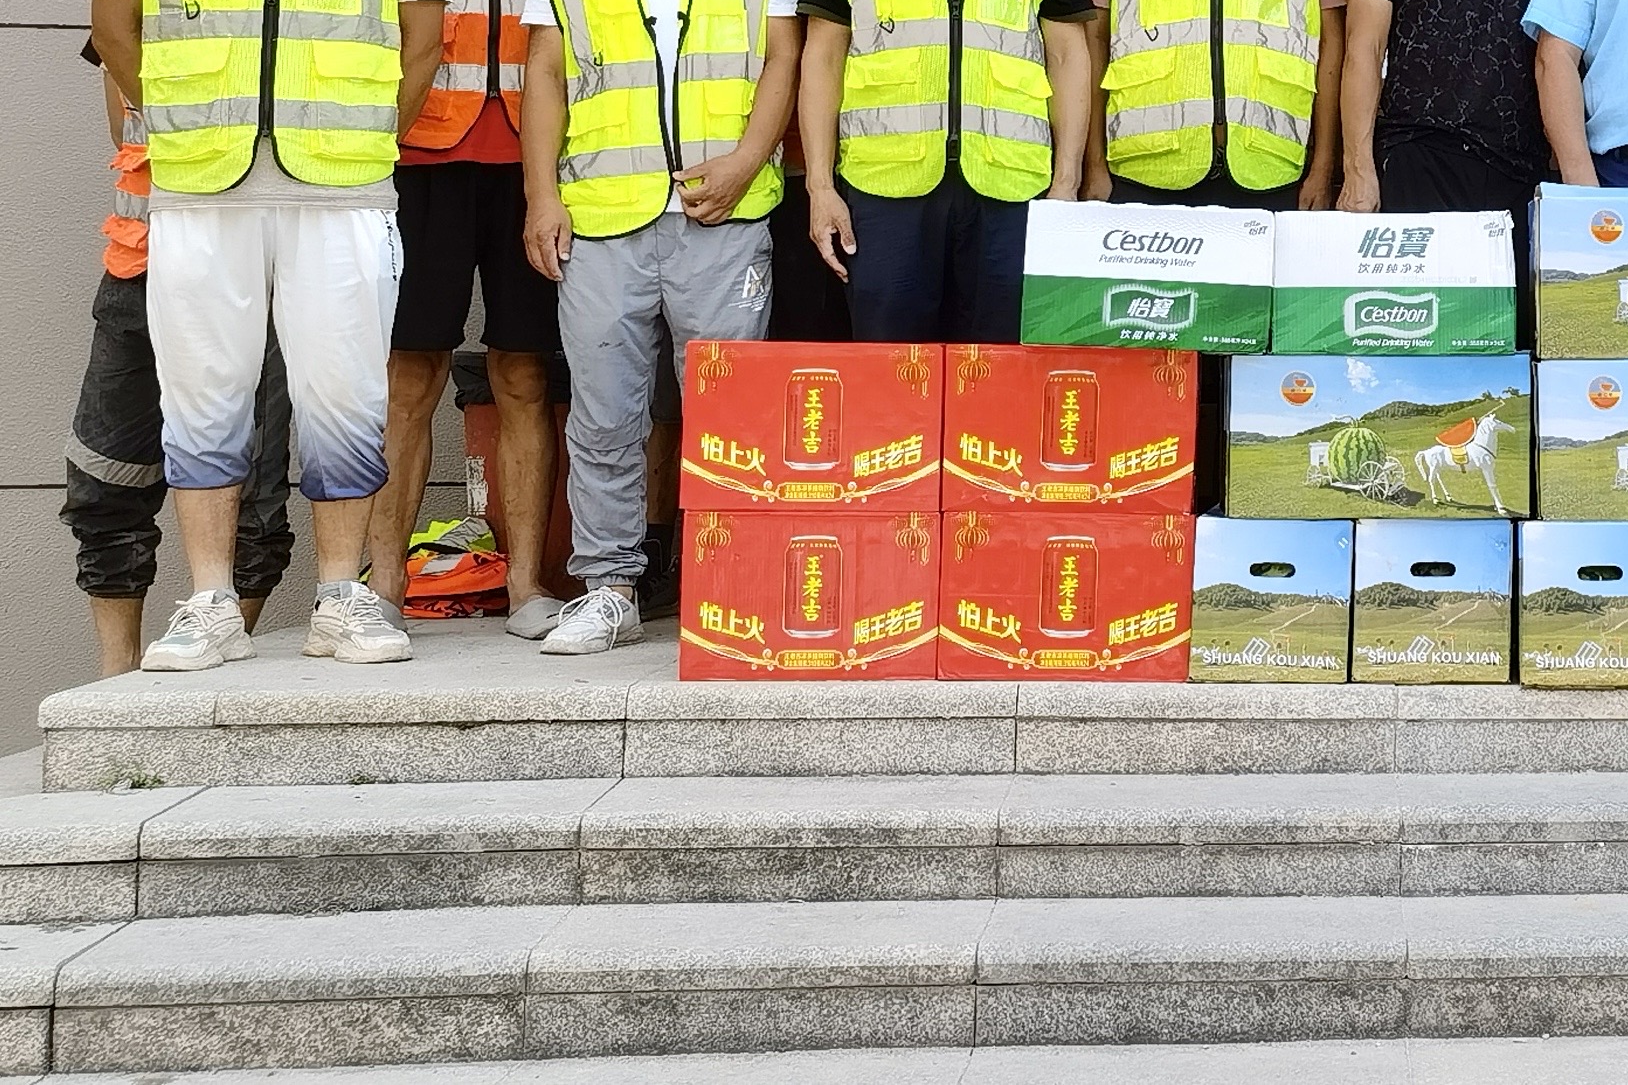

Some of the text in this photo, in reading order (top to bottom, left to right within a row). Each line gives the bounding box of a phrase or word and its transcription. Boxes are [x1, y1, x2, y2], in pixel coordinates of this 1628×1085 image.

[1099, 254, 1133, 264] Purified
[1358, 262, 1426, 274] 饮用纯净水
[802, 388, 823, 454] 王老吉
[1059, 389, 1080, 456] 王老吉
[700, 433, 768, 476] 怕上火
[853, 434, 925, 478] 喝王老吉
[960, 433, 1023, 477] 怕上火
[1109, 434, 1180, 479] 喝王老吉
[802, 555, 823, 623] 王老吉
[1058, 555, 1079, 623] 王老吉
[699, 600, 766, 645] 怕上火
[853, 600, 924, 646] 喝王老吉
[957, 599, 1022, 645] 怕上火
[1108, 601, 1179, 646] 喝王老吉
[1202, 651, 1336, 666] SHUANG KOU XIAN
[1368, 650, 1500, 664] SHUANG KOU XIAN
[1536, 655, 1595, 670] SHUANG
